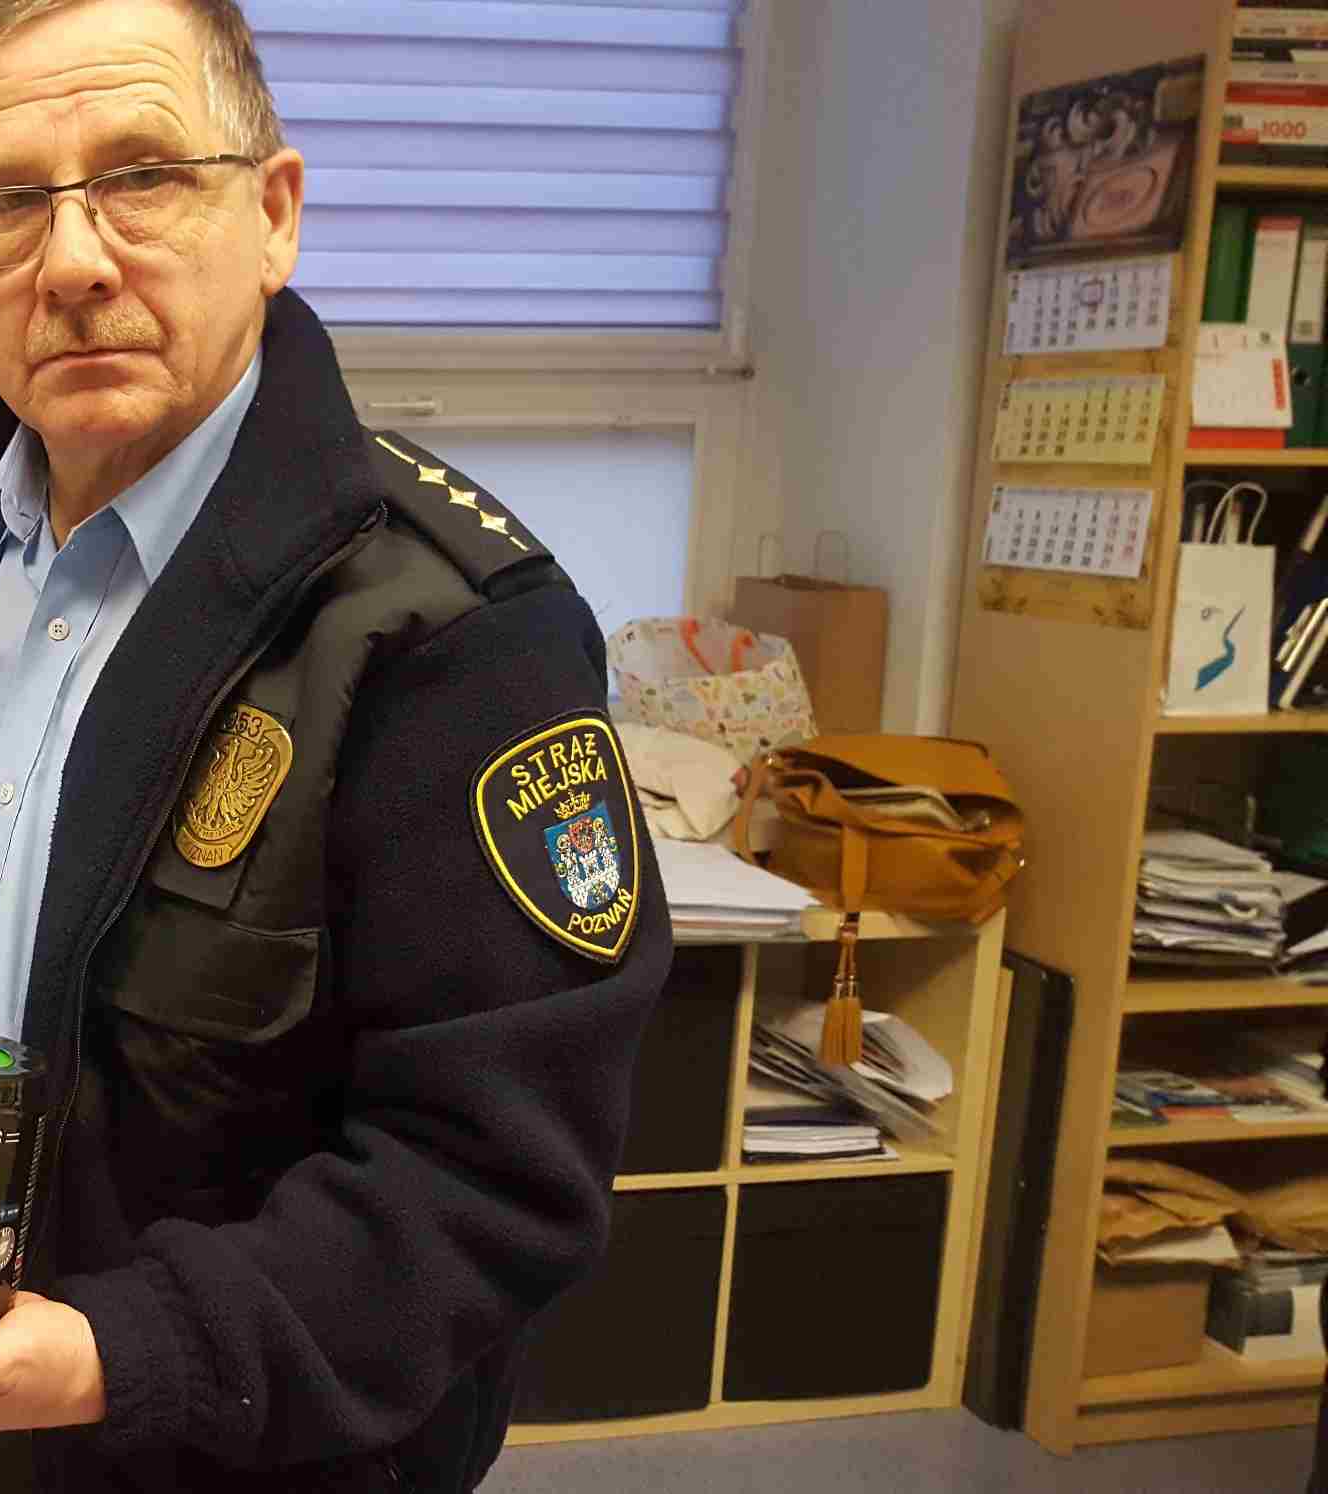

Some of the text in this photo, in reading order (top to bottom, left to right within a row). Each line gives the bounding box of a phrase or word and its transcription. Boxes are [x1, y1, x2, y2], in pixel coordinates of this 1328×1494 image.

[510, 732, 598, 786] STRAŻ
[505, 756, 608, 822] MIEJSKA
[567, 887, 633, 934] POZNAŃ
